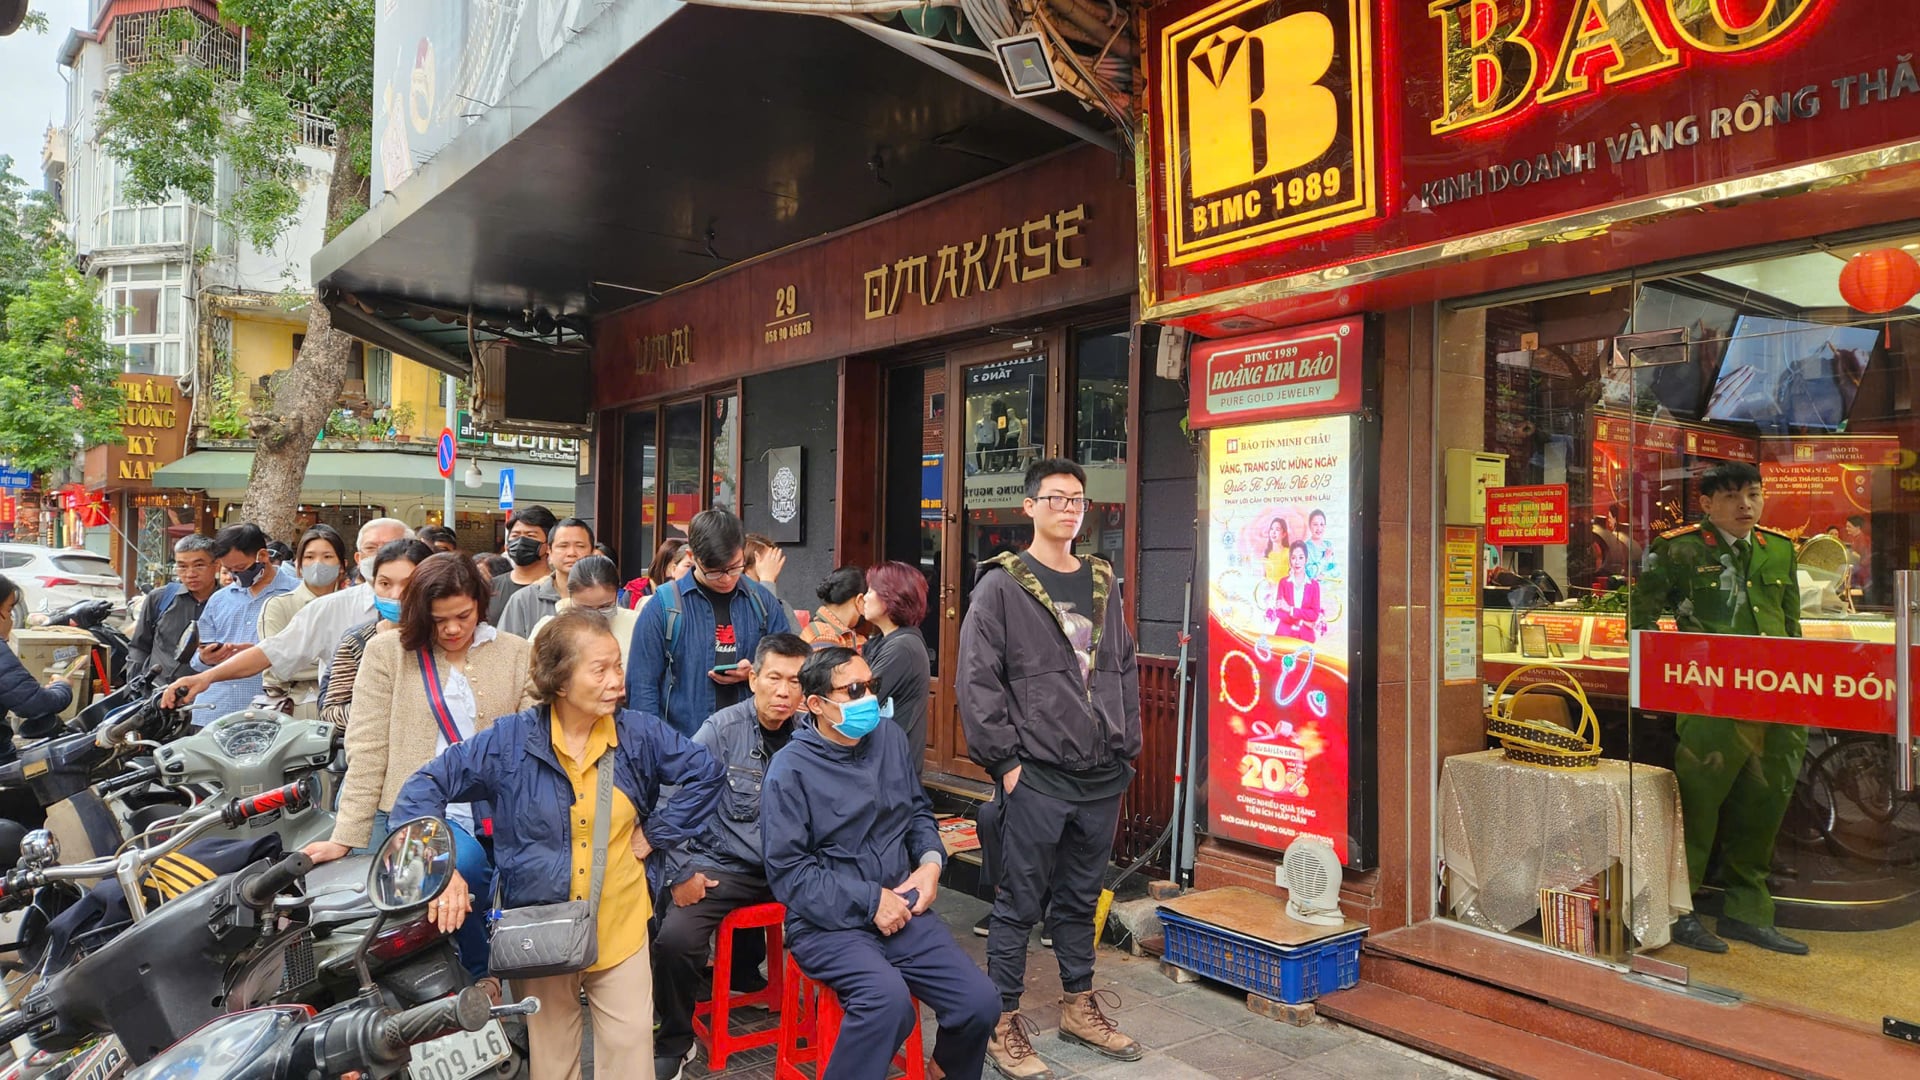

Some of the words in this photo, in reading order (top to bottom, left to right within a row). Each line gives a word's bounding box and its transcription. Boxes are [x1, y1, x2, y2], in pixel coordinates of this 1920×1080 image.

[1420, 168, 1483, 208] KINH
[1488, 141, 1596, 193] DOANH
[1604, 114, 1700, 164] VÀNG
[1710, 85, 1821, 139] RỒNG
[1193, 190, 1261, 232] BTMC
[1272, 167, 1341, 210] 1989
[864, 203, 1085, 320] OMAKASE
[776, 285, 796, 317] 29
[1211, 363, 1263, 390] HOÀNG
[1265, 361, 1295, 383] KIM
[1298, 351, 1334, 379] BẢO
[1244, 350, 1273, 364] BTMC
[1275, 346, 1298, 360] 1989
[1220, 396, 1244, 407] PURE
[1247, 391, 1274, 404] GOLD
[1276, 386, 1322, 401] JEWELRY
[1276, 437, 1302, 448] MINH
[1304, 432, 1331, 445] CHÂU
[1243, 461, 1270, 473] TRANG
[1310, 473, 1332, 490] 8/3
[1664, 660, 1724, 687] HÂN
[1734, 668, 1823, 695] HOAN
[1241, 754, 1309, 797] 20%
